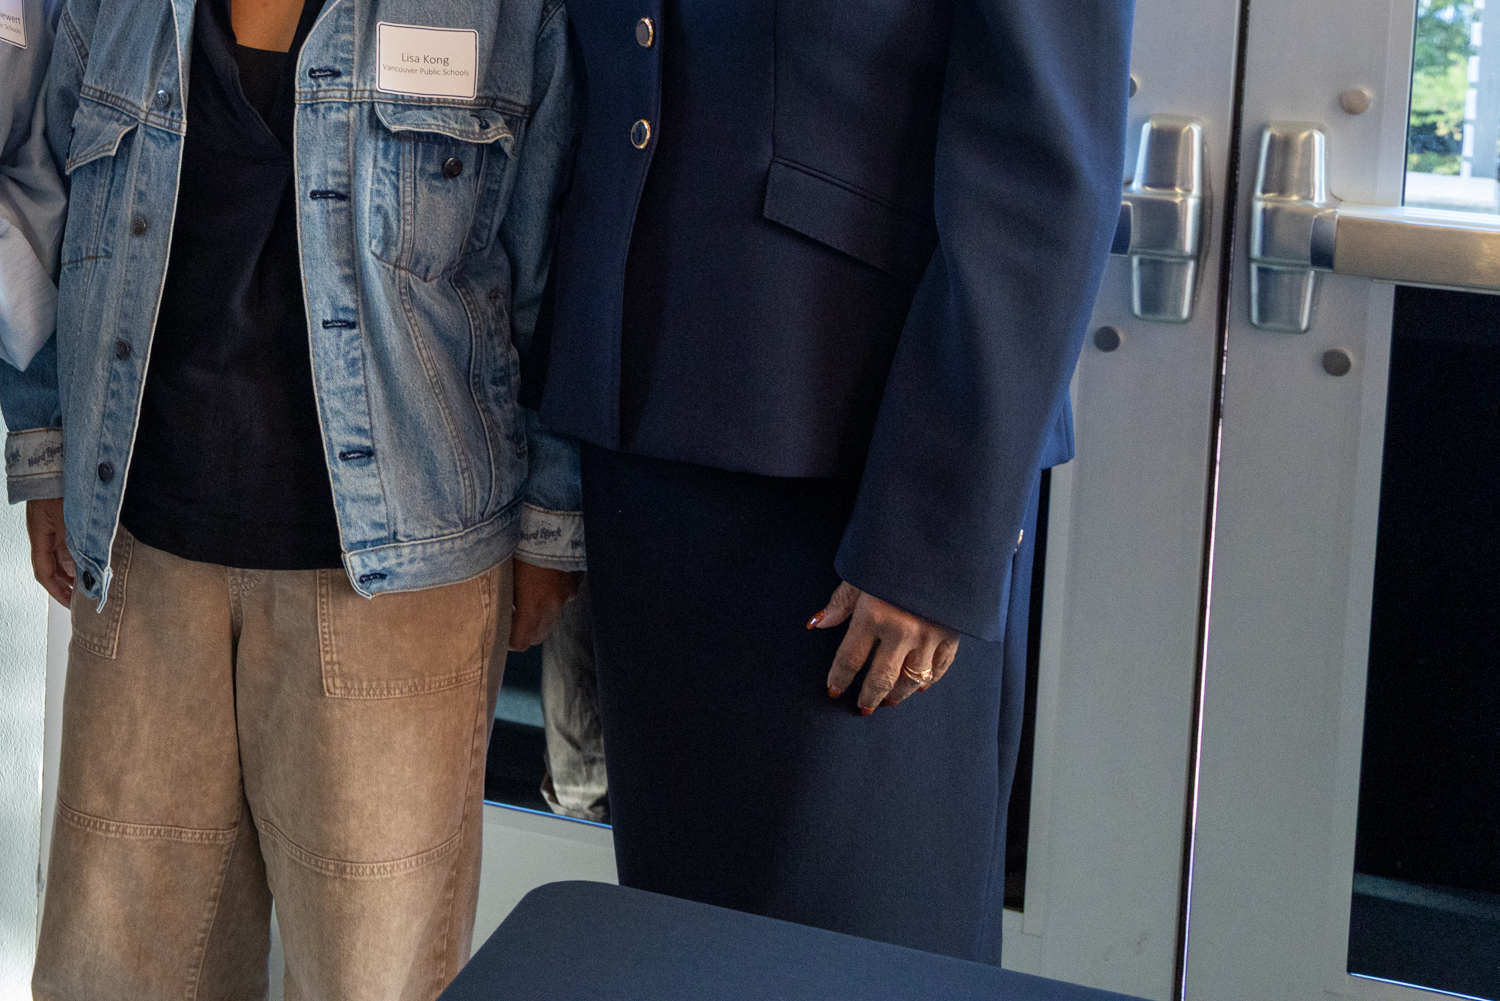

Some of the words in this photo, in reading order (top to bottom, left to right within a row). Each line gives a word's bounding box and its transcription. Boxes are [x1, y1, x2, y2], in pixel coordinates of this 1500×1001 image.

[401, 52, 420, 63] Lisa
[423, 54, 450, 66] Kong
[382, 63, 418, 74] Vancouver
[420, 67, 441, 76] Public
[442, 68, 470, 77] Schools
